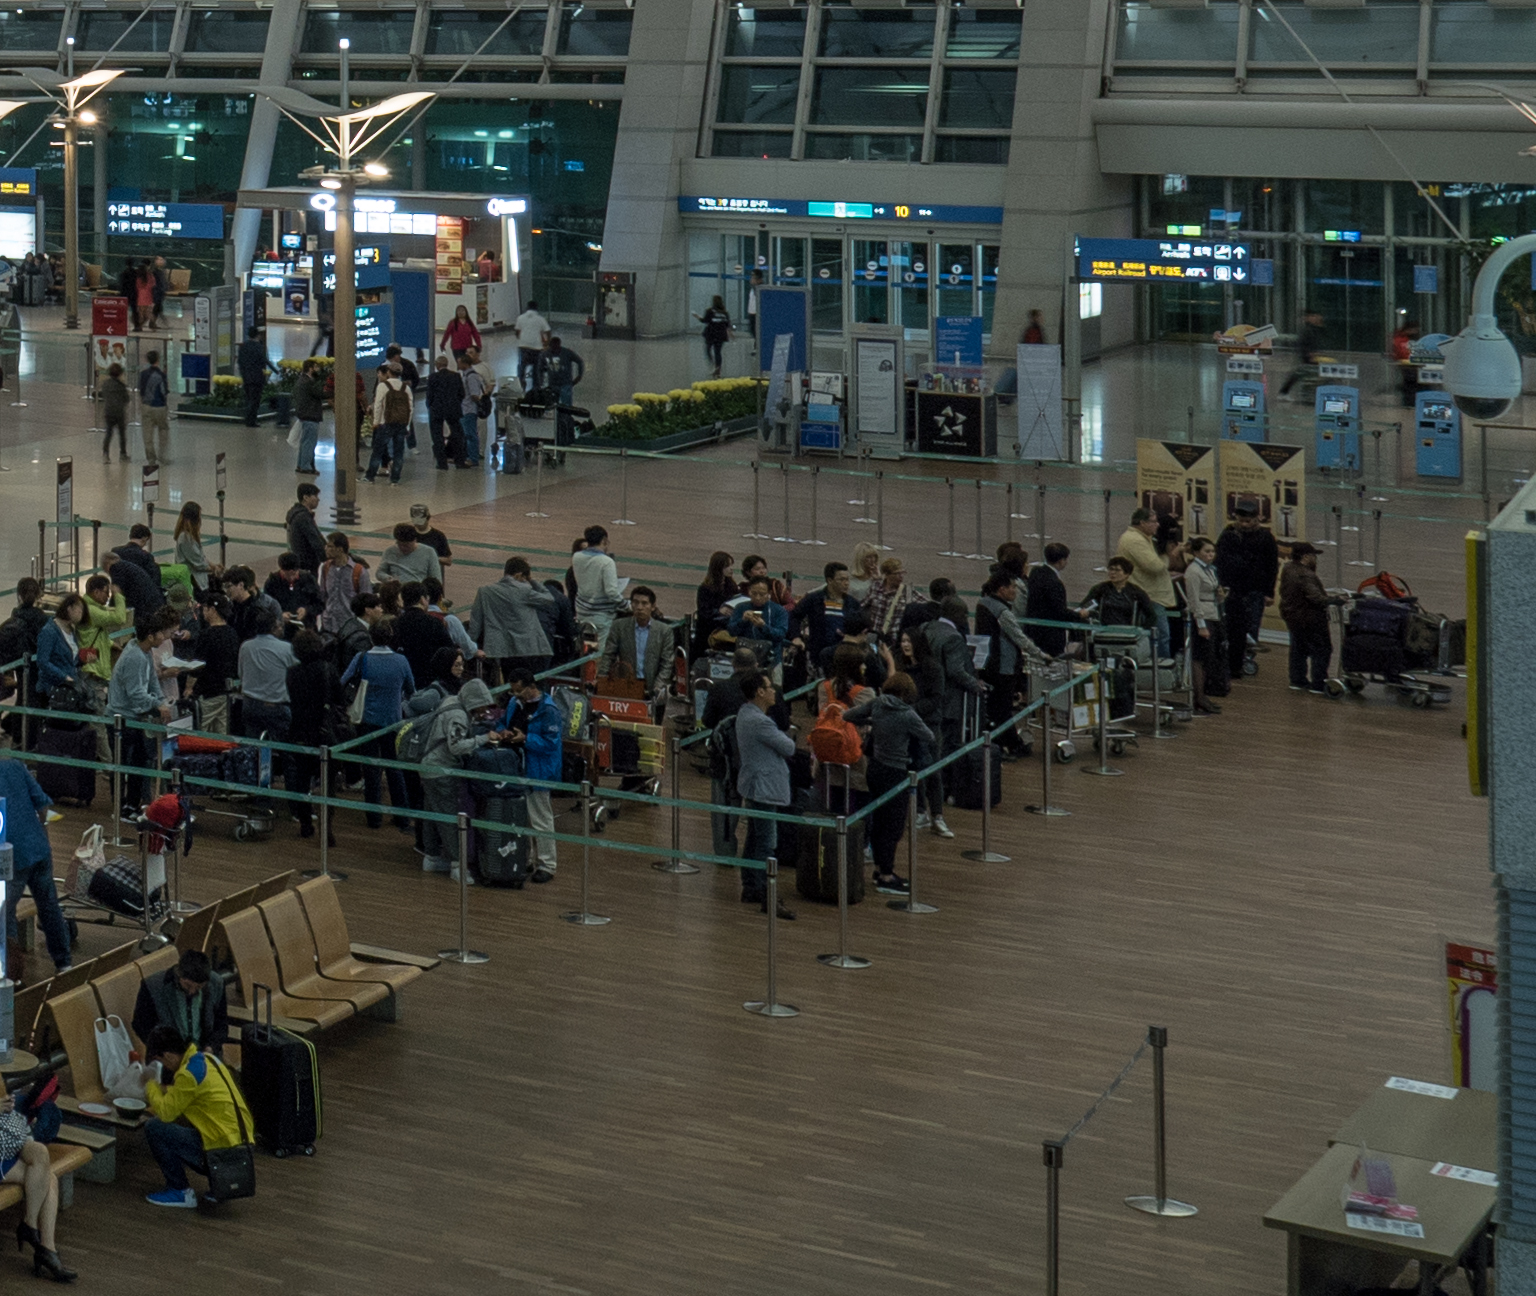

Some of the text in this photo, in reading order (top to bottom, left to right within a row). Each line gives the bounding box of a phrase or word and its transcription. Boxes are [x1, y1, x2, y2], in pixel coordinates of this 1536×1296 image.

[893, 205, 909, 218] 10
[373, 247, 380, 263] 3
[1092, 268, 1147, 278] Airport Railroad
[608, 700, 630, 714] TRY
